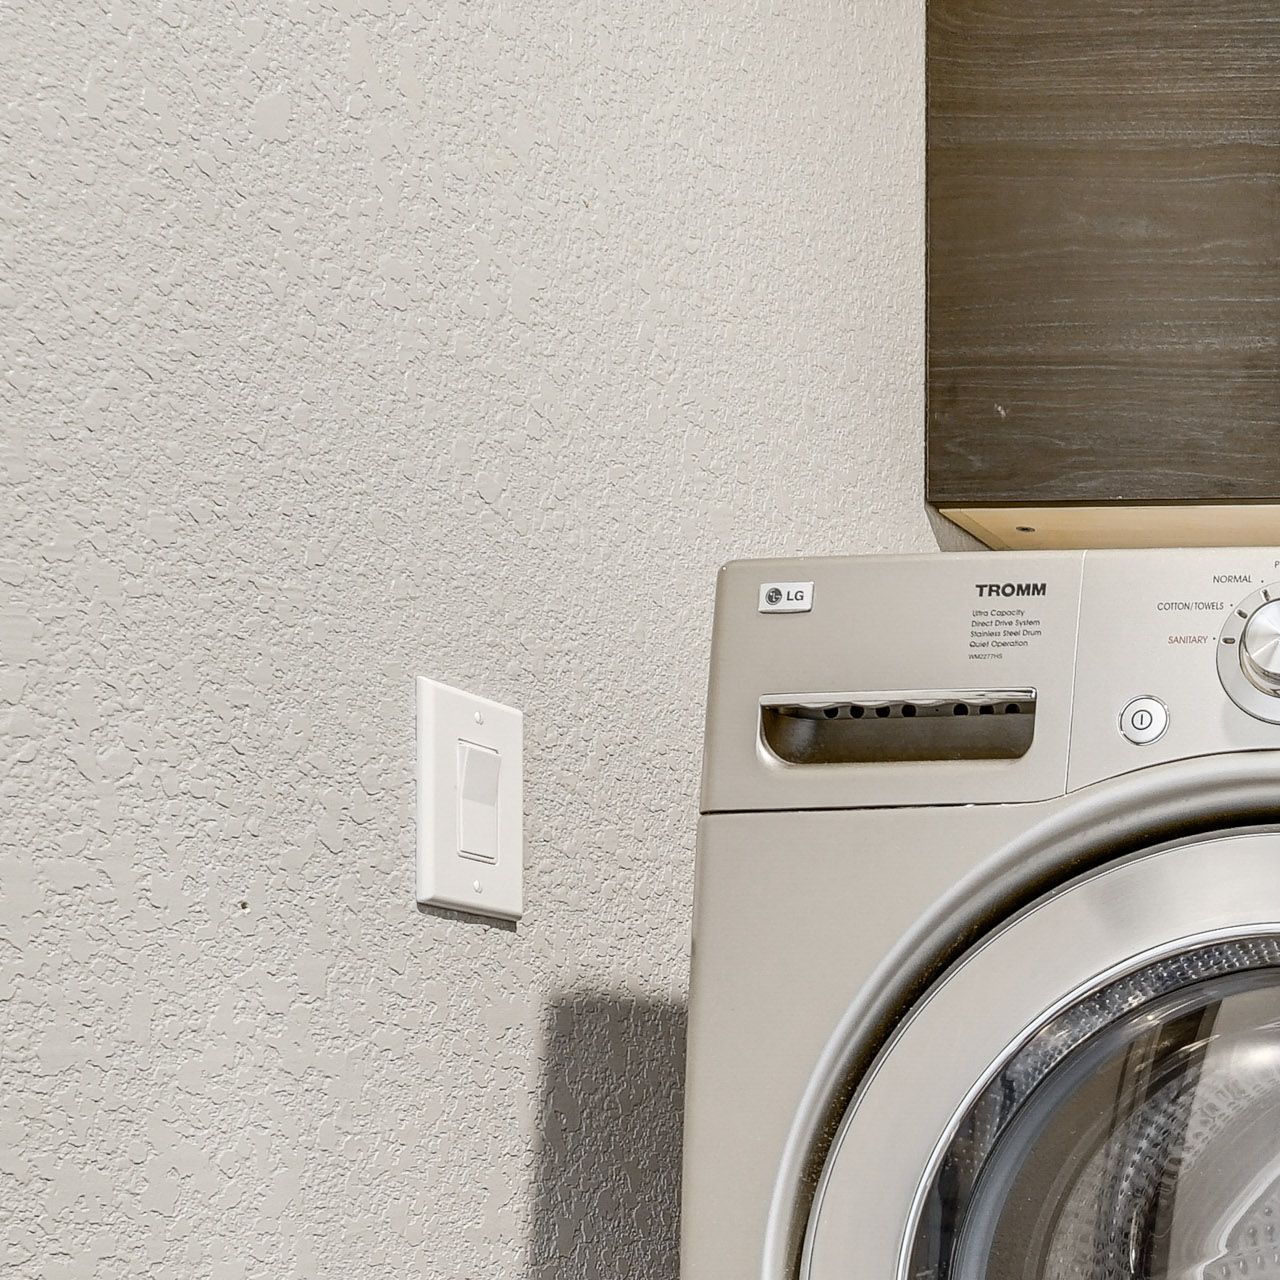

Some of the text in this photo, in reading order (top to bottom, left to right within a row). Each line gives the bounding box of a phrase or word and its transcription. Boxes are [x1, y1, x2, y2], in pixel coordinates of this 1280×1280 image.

[1213, 575, 1252, 583] NORMAL
[975, 583, 1047, 597] TROMM
[787, 591, 804, 601] LG
[1157, 602, 1224, 611] COTTON/TOWELS
[990, 609, 1025, 617] Capacity
[1015, 619, 1040, 627] System
[991, 640, 1028, 648] Operation
[1168, 636, 1208, 644] SANITARY
